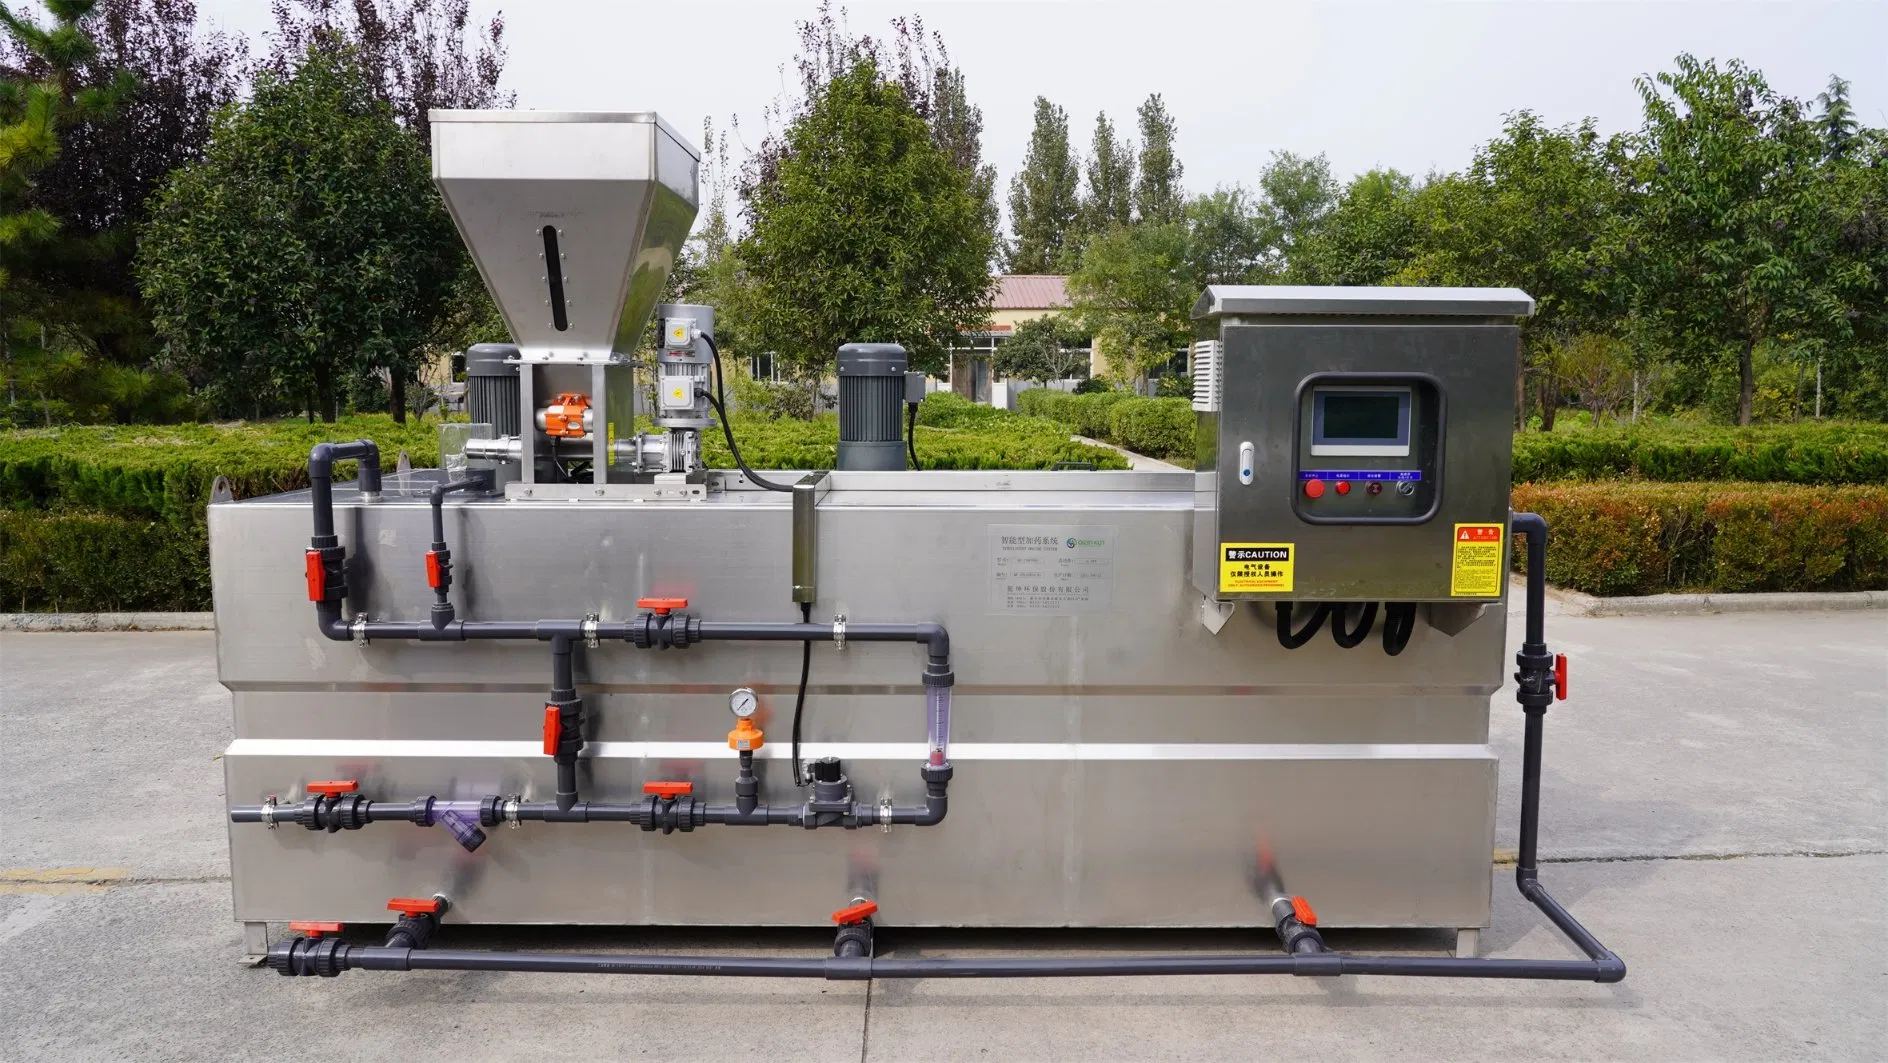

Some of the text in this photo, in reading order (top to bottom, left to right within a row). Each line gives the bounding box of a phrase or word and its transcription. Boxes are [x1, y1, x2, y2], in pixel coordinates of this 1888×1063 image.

[1001, 536, 1059, 545] 智能型加药系统
